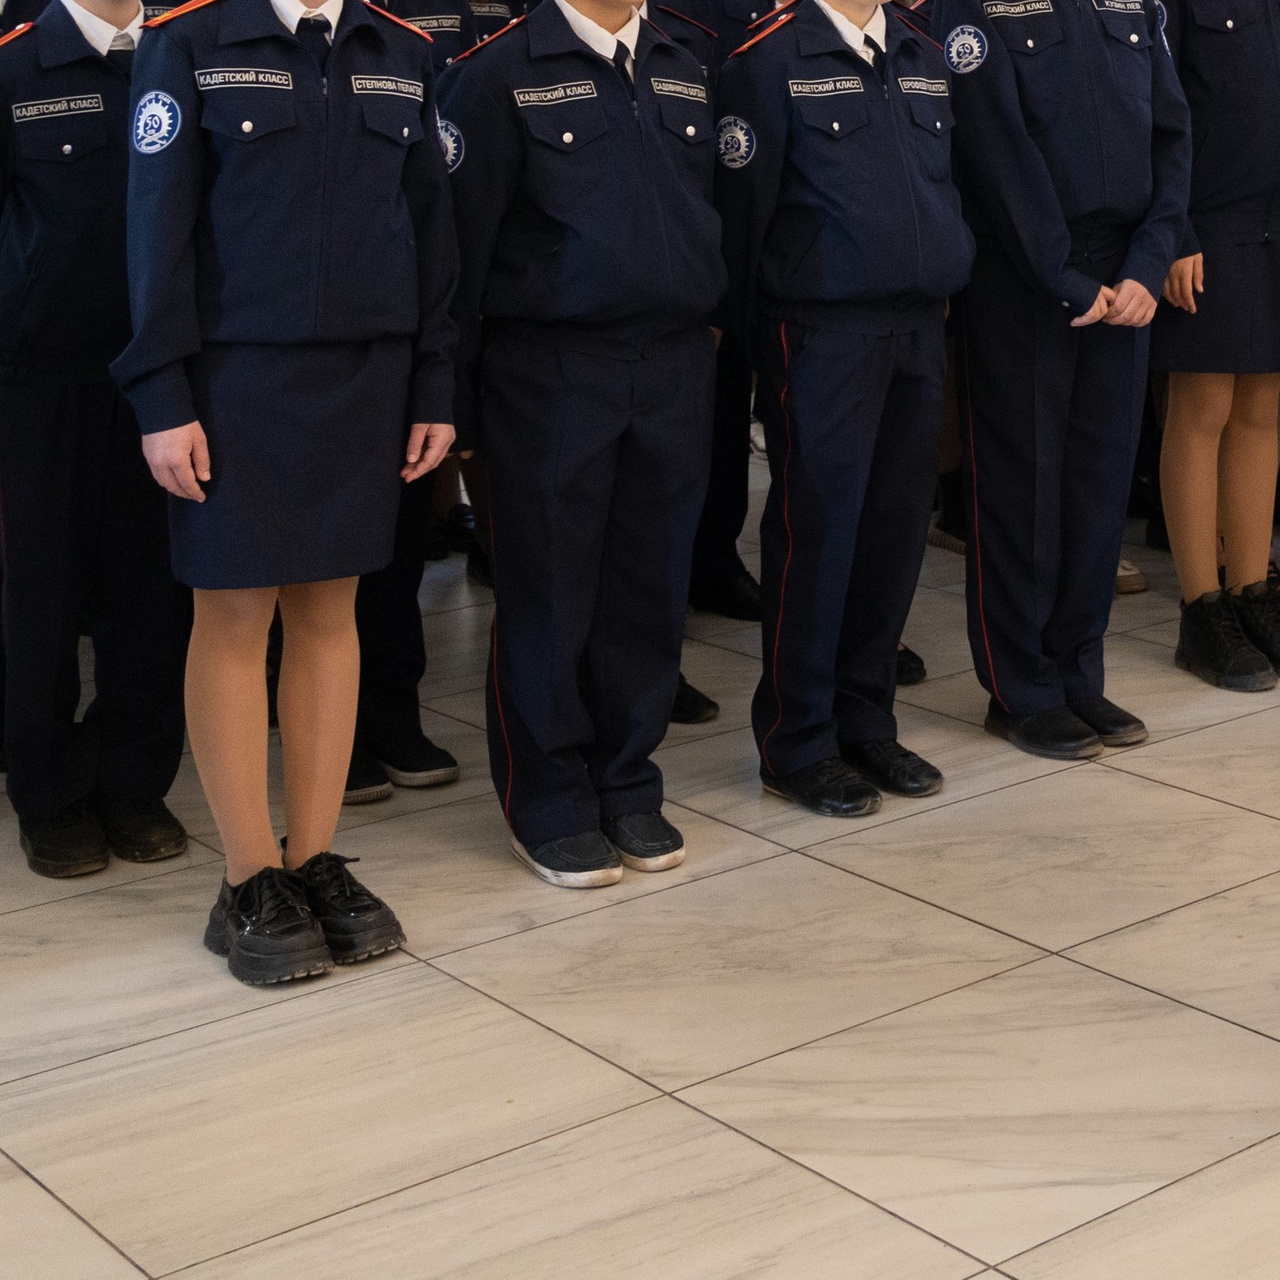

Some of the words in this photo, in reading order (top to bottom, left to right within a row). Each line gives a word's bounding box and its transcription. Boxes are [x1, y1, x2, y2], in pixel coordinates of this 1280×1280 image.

[987, 4, 1026, 14] КАДЕТСКИЙ
[1026, 1, 1049, 11] КЛАСС
[1126, 2, 1141, 10] ЛЕВ
[200, 71, 256, 85] КАДЕТСКИЙ
[258, 73, 289, 85] КЛАСС
[355, 79, 397, 91] СТЕПНОВА
[792, 81, 835, 93] КАДЕТСКИЙ
[835, 80, 860, 90] КЛАСС
[518, 88, 565, 102] КАДЕТСКИЙ
[566, 85, 593, 96] КЛАСС
[15, 101, 68, 118] КАДЕТСКИЙ
[69, 98, 99, 110] КЛАСС
[145, 116, 160, 130] 50
